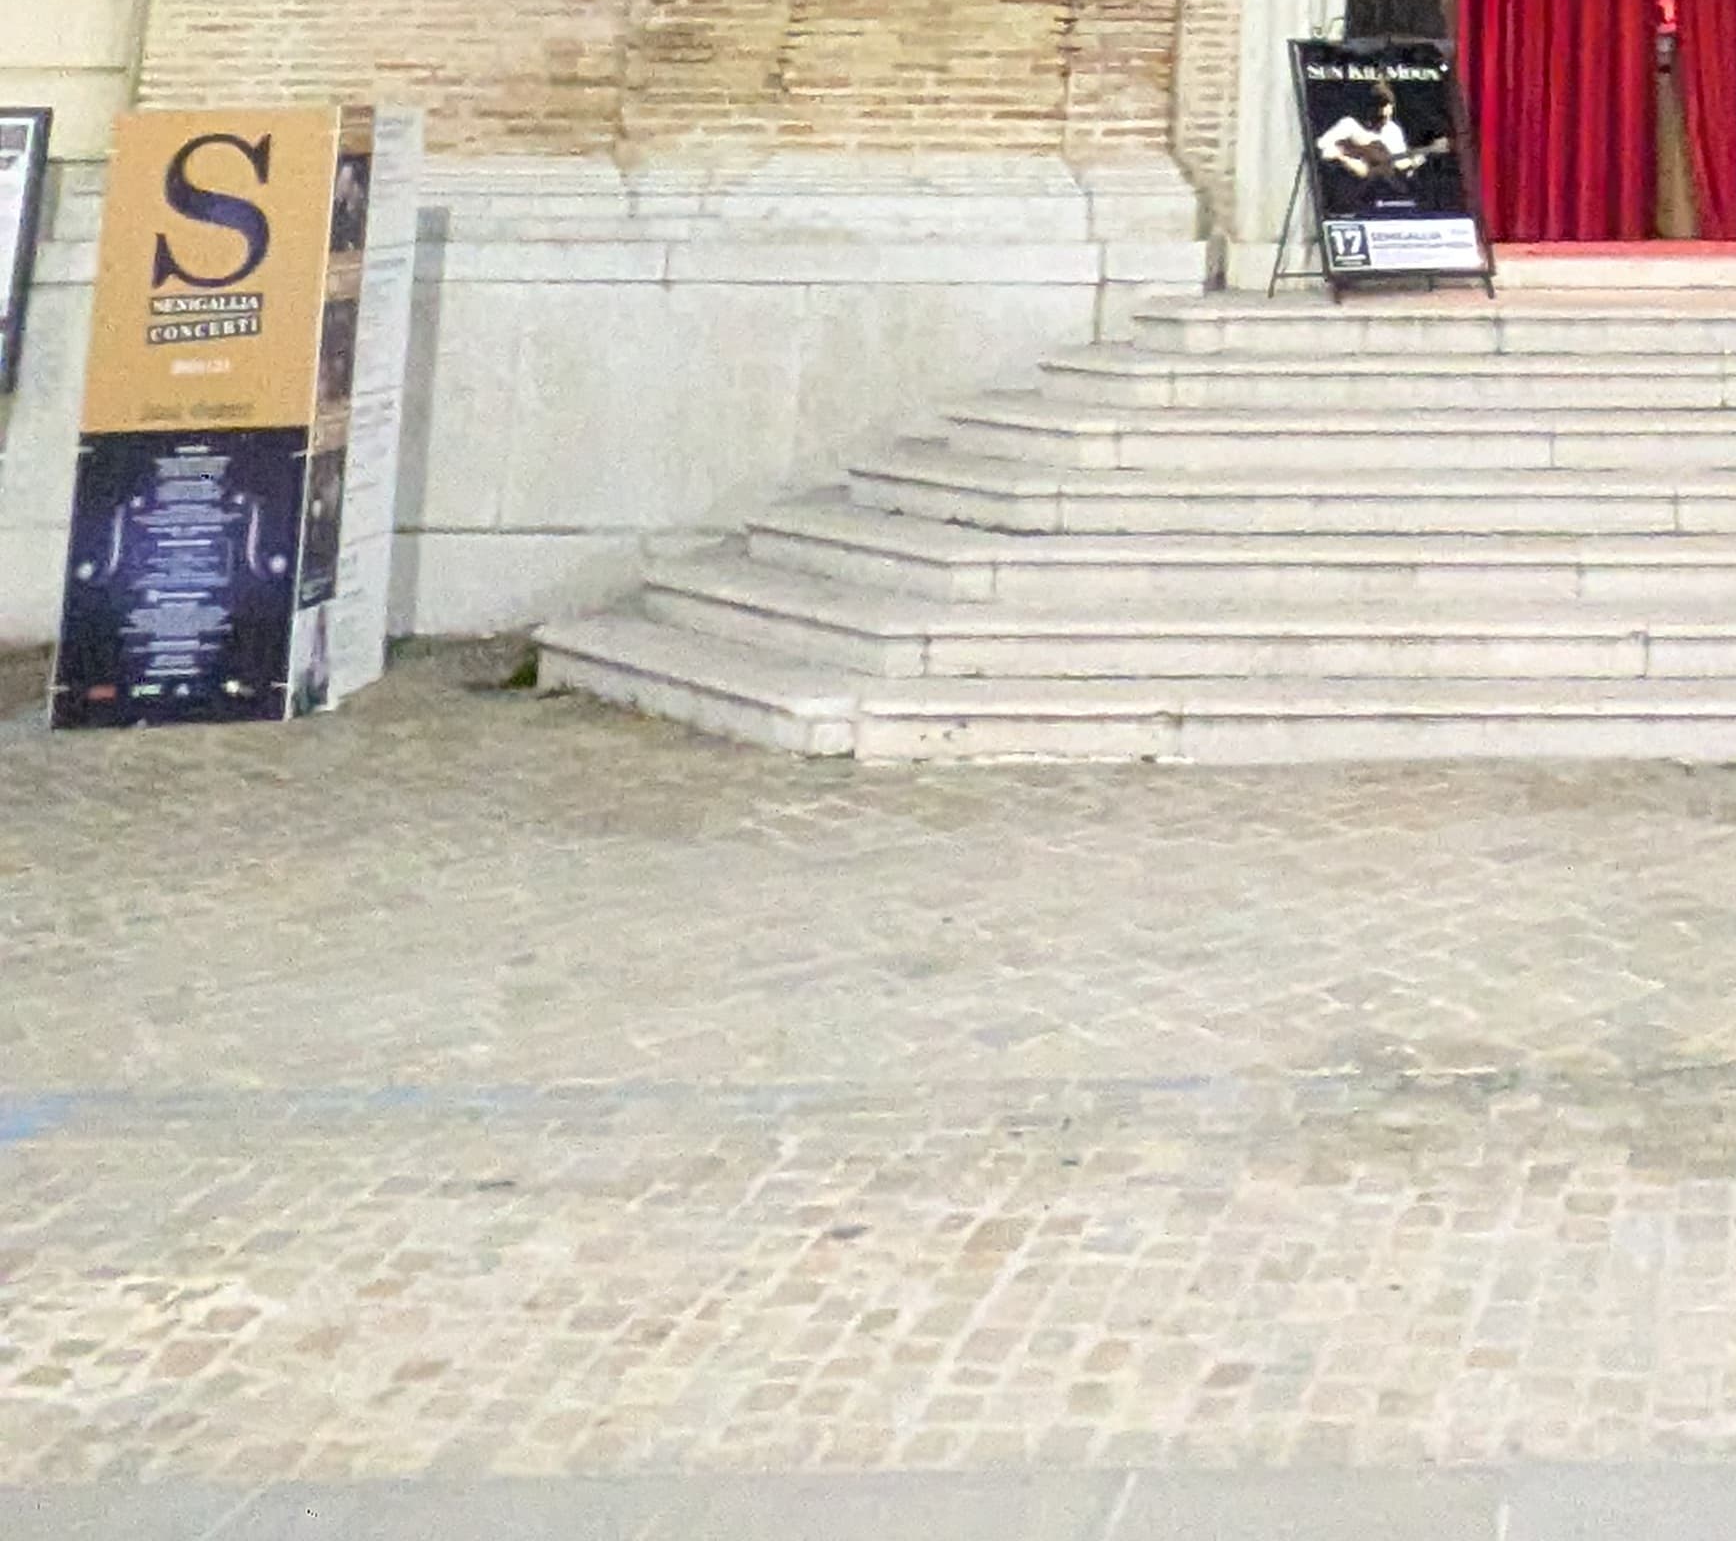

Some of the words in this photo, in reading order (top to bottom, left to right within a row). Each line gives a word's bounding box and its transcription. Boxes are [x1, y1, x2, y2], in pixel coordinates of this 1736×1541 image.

[153, 133, 271, 288] S
[1331, 229, 1363, 256] 17
[149, 318, 258, 342] CONCERTI
